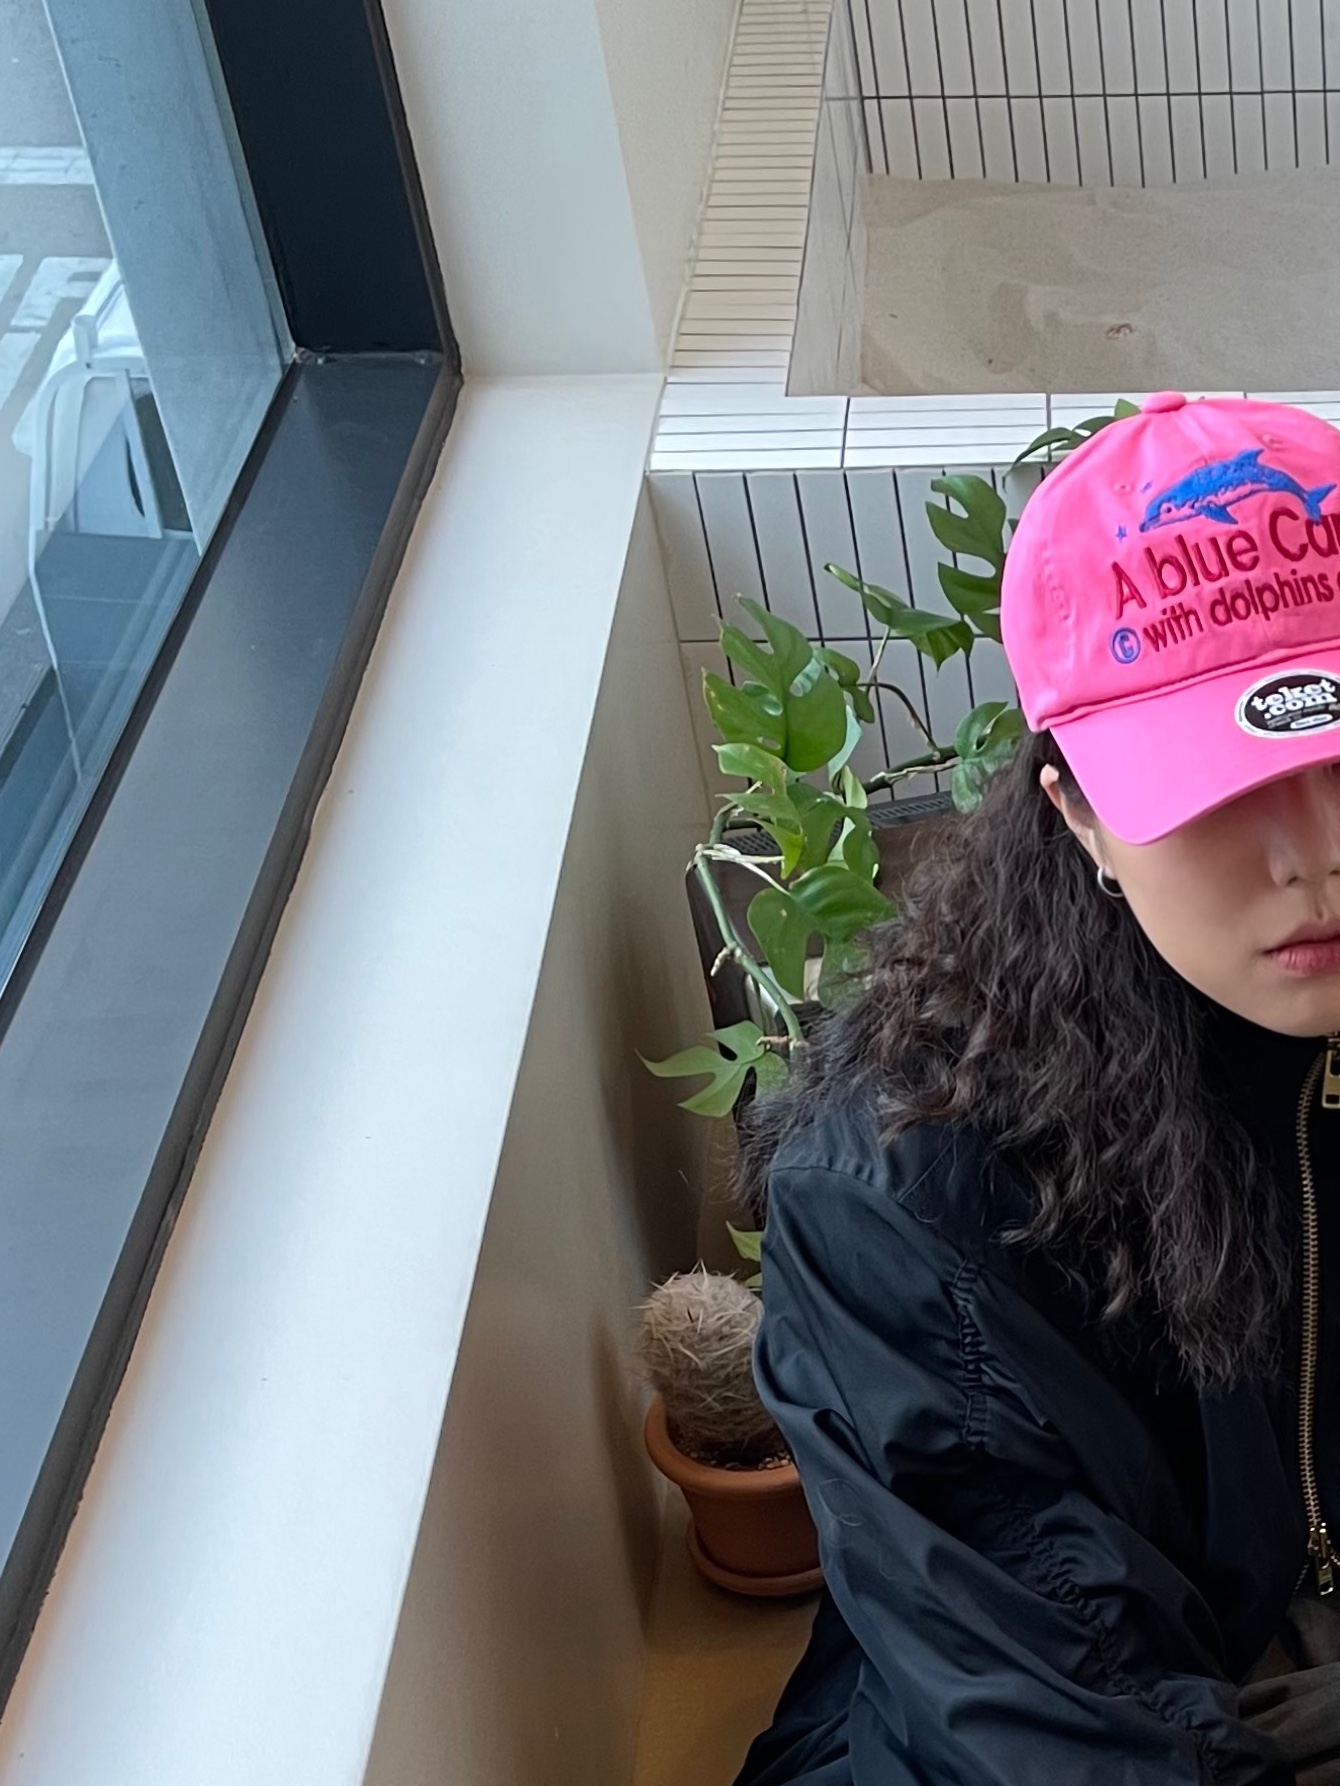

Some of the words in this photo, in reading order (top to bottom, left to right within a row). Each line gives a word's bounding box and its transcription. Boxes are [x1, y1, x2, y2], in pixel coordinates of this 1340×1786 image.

[1111, 561, 1147, 620] A
[1144, 530, 1260, 599] blue
[1143, 602, 1204, 652] with
[1210, 568, 1334, 626] dolphins
